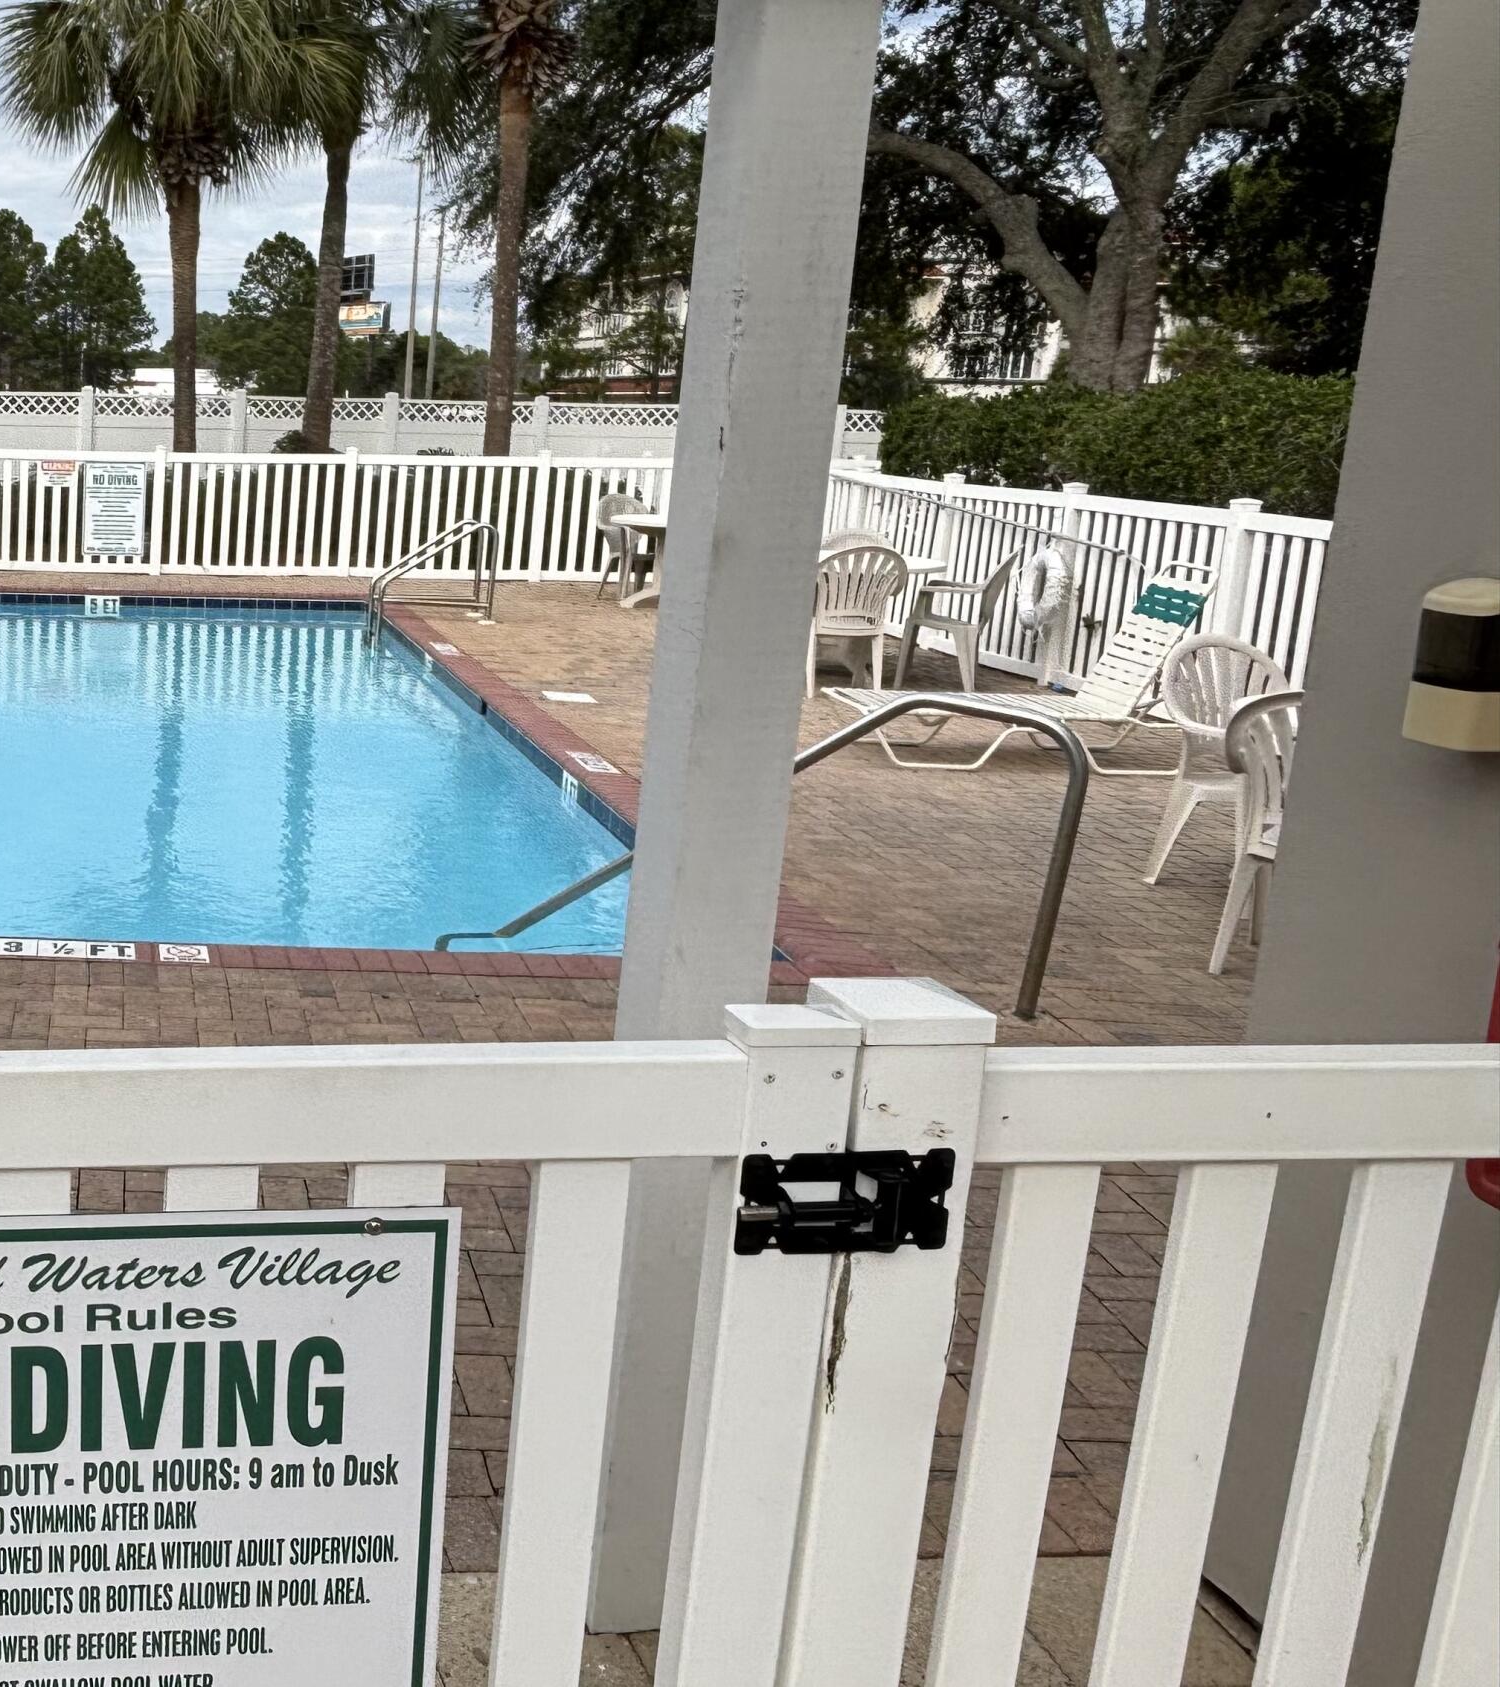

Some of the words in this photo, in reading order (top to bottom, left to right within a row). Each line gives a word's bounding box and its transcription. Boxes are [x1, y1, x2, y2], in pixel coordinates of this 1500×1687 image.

[3, 941, 23, 953] 3
[21, 1252, 206, 1293] Waters
[217, 1246, 401, 1299] Village
[86, 1301, 237, 1332] Rules
[10, 1335, 345, 1454] DIVING
[83, 1460, 145, 1495] POOL
[152, 1457, 240, 1492] HOURS:
[248, 1457, 263, 1490] 9
[270, 1463, 305, 1489] am
[312, 1456, 335, 1488] to
[343, 1453, 399, 1487] Dusk
[9, 1503, 97, 1535] SWIMMING
[100, 1502, 149, 1532] AFTER
[154, 1500, 197, 1531] DARK
[48, 1544, 65, 1574] IN
[69, 1543, 111, 1573] POOL
[115, 1541, 158, 1572] AREA
[160, 1539, 233, 1570] WITHOUT
[235, 1538, 286, 1568] ADULT
[289, 1534, 399, 1566] SUPERVISION.
[78, 1585, 101, 1614] OR
[106, 1582, 174, 1613] BOTTLES
[177, 1580, 251, 1611] ALLOWED
[256, 1579, 273, 1608] IN
[277, 1578, 319, 1607] POOL
[322, 1576, 371, 1606] AREA.
[44, 1633, 72, 1662] OFF
[76, 1631, 137, 1661] BEFORE
[142, 1628, 221, 1659] ENTERING
[226, 1626, 274, 1656] POOL.
